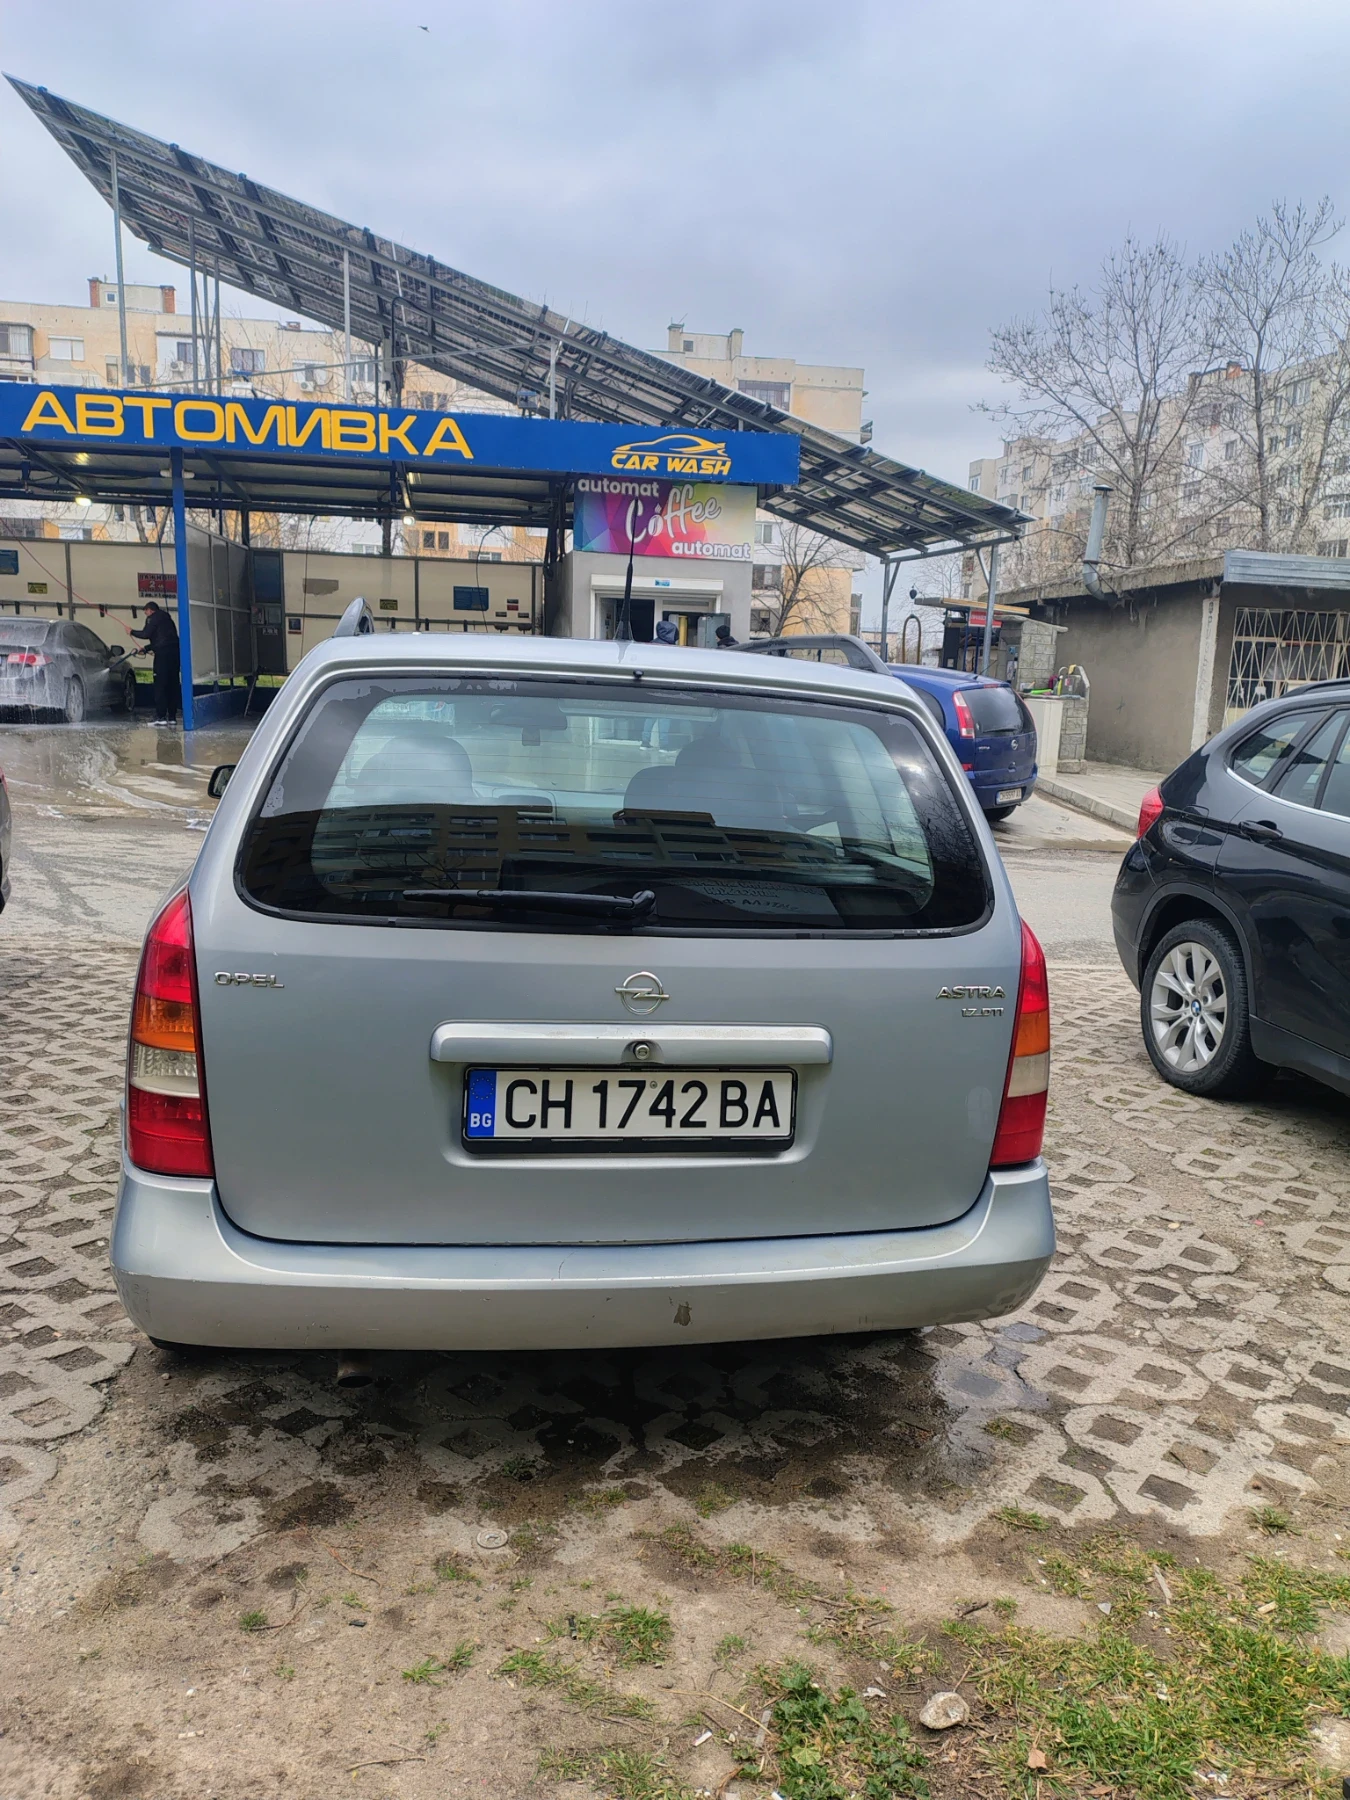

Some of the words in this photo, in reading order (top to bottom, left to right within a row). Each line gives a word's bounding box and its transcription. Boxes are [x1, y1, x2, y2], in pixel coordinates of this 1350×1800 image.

[21, 391, 475, 459] АВТОМИВКА
[611, 453, 660, 471] CAR
[667, 457, 732, 475] WASH
[577, 477, 660, 497] automat
[625, 484, 722, 543] Coffee
[671, 540, 751, 558] automat
[214, 971, 285, 988] OPEL
[936, 986, 1005, 999] ASTRA
[505, 1079, 574, 1129] CH
[592, 1079, 708, 1129] 1742
[719, 1079, 781, 1129] BA
[470, 1113, 492, 1127] BG
